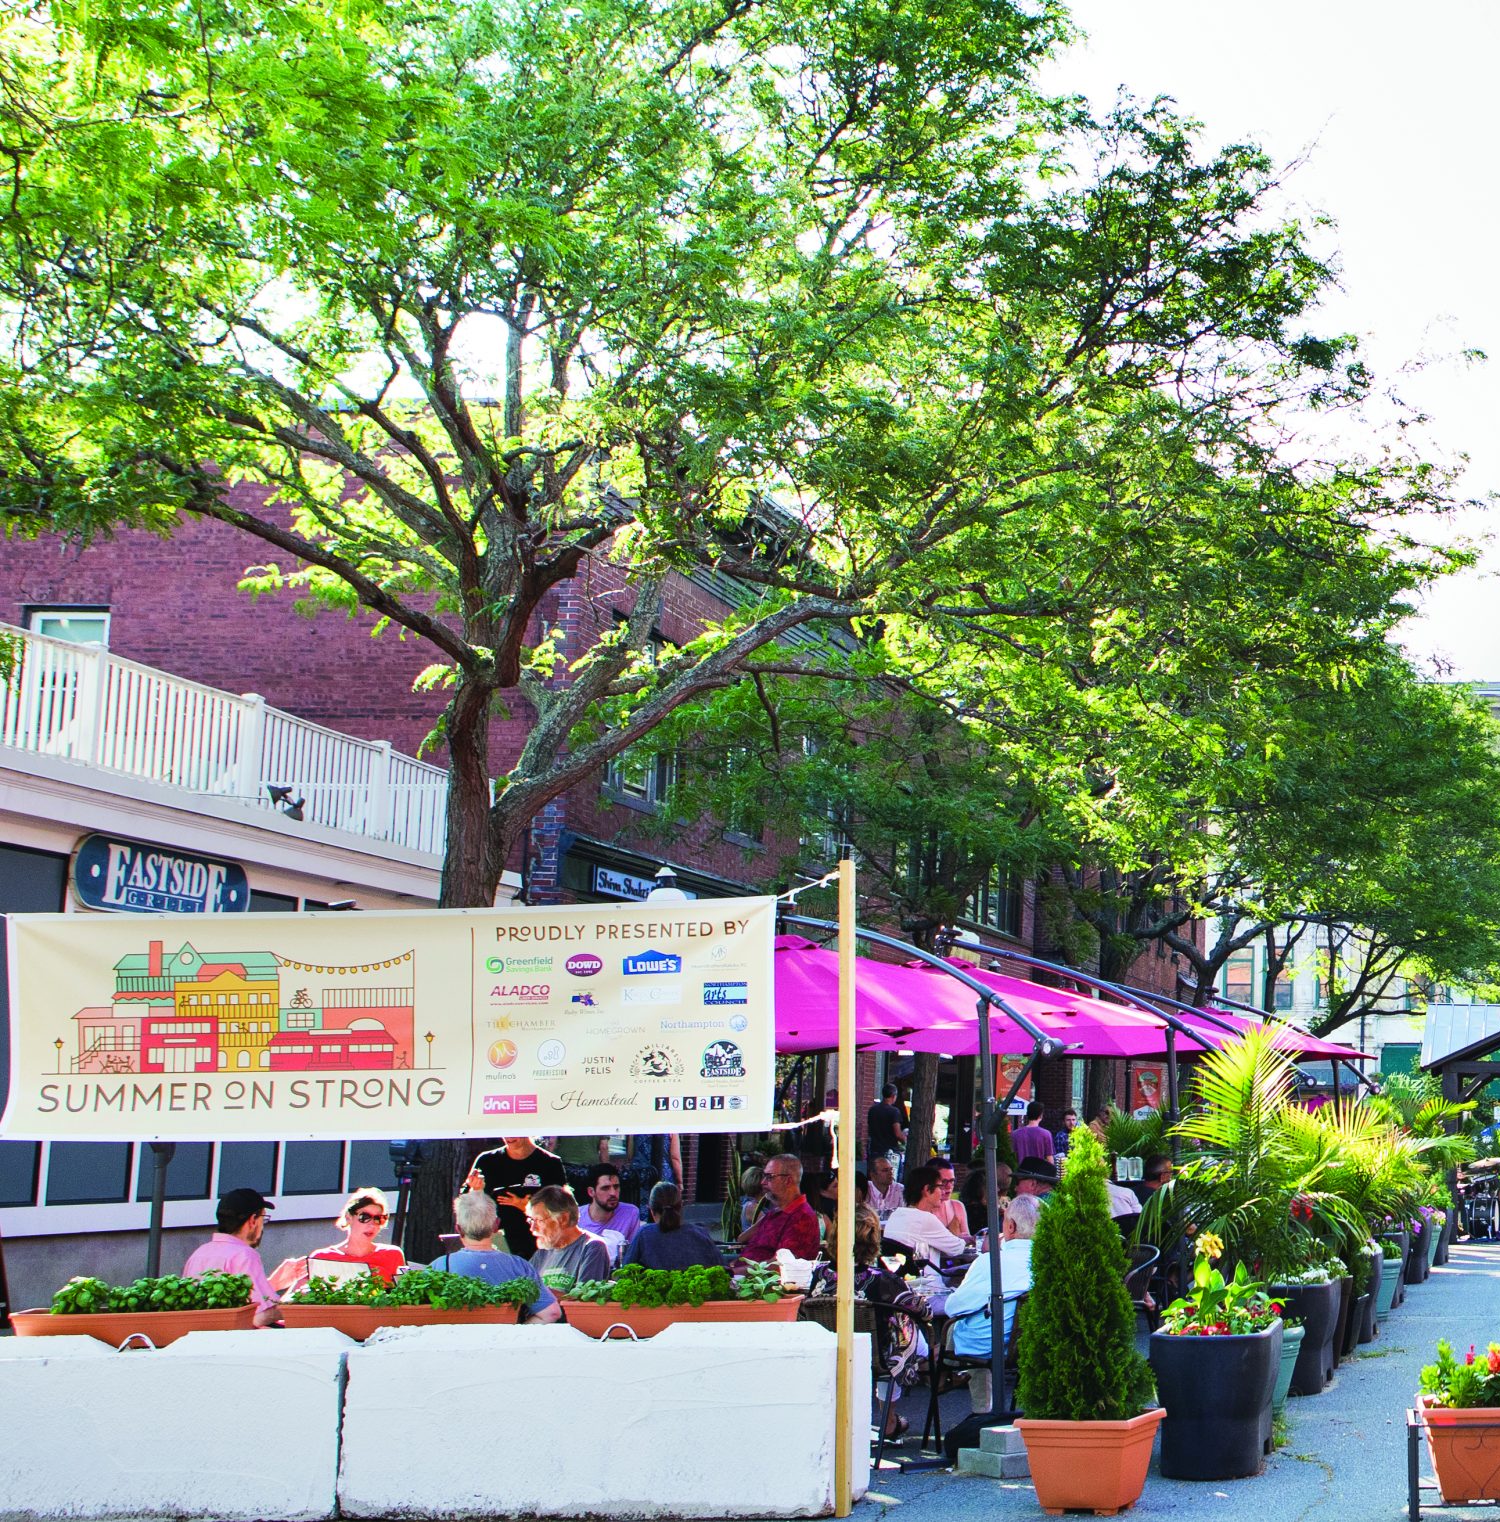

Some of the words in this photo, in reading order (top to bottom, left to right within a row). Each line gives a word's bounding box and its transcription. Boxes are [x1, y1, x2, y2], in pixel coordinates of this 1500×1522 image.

[102, 843, 227, 913] EASTSIDE
[598, 871, 621, 892] Shiva
[496, 925, 585, 942] PROUDLY
[596, 921, 713, 940] PRESENTED
[724, 920, 749, 936] BY
[505, 957, 553, 965] Greenfield
[567, 961, 601, 969] DOWD
[628, 959, 677, 972] LOWE'S
[534, 965, 552, 973] Bank
[490, 985, 550, 996] ALADCO
[703, 986, 727, 1000] arts
[511, 1020, 556, 1028] CHAMBER
[660, 1019, 724, 1029] Northampton
[485, 1071, 516, 1080] mulino's
[704, 1068, 742, 1076] EASTSIDE
[37, 1081, 212, 1113] SUMMER
[223, 1080, 274, 1110] ON
[288, 1078, 446, 1109] STRONG
[483, 1097, 511, 1110] dna
